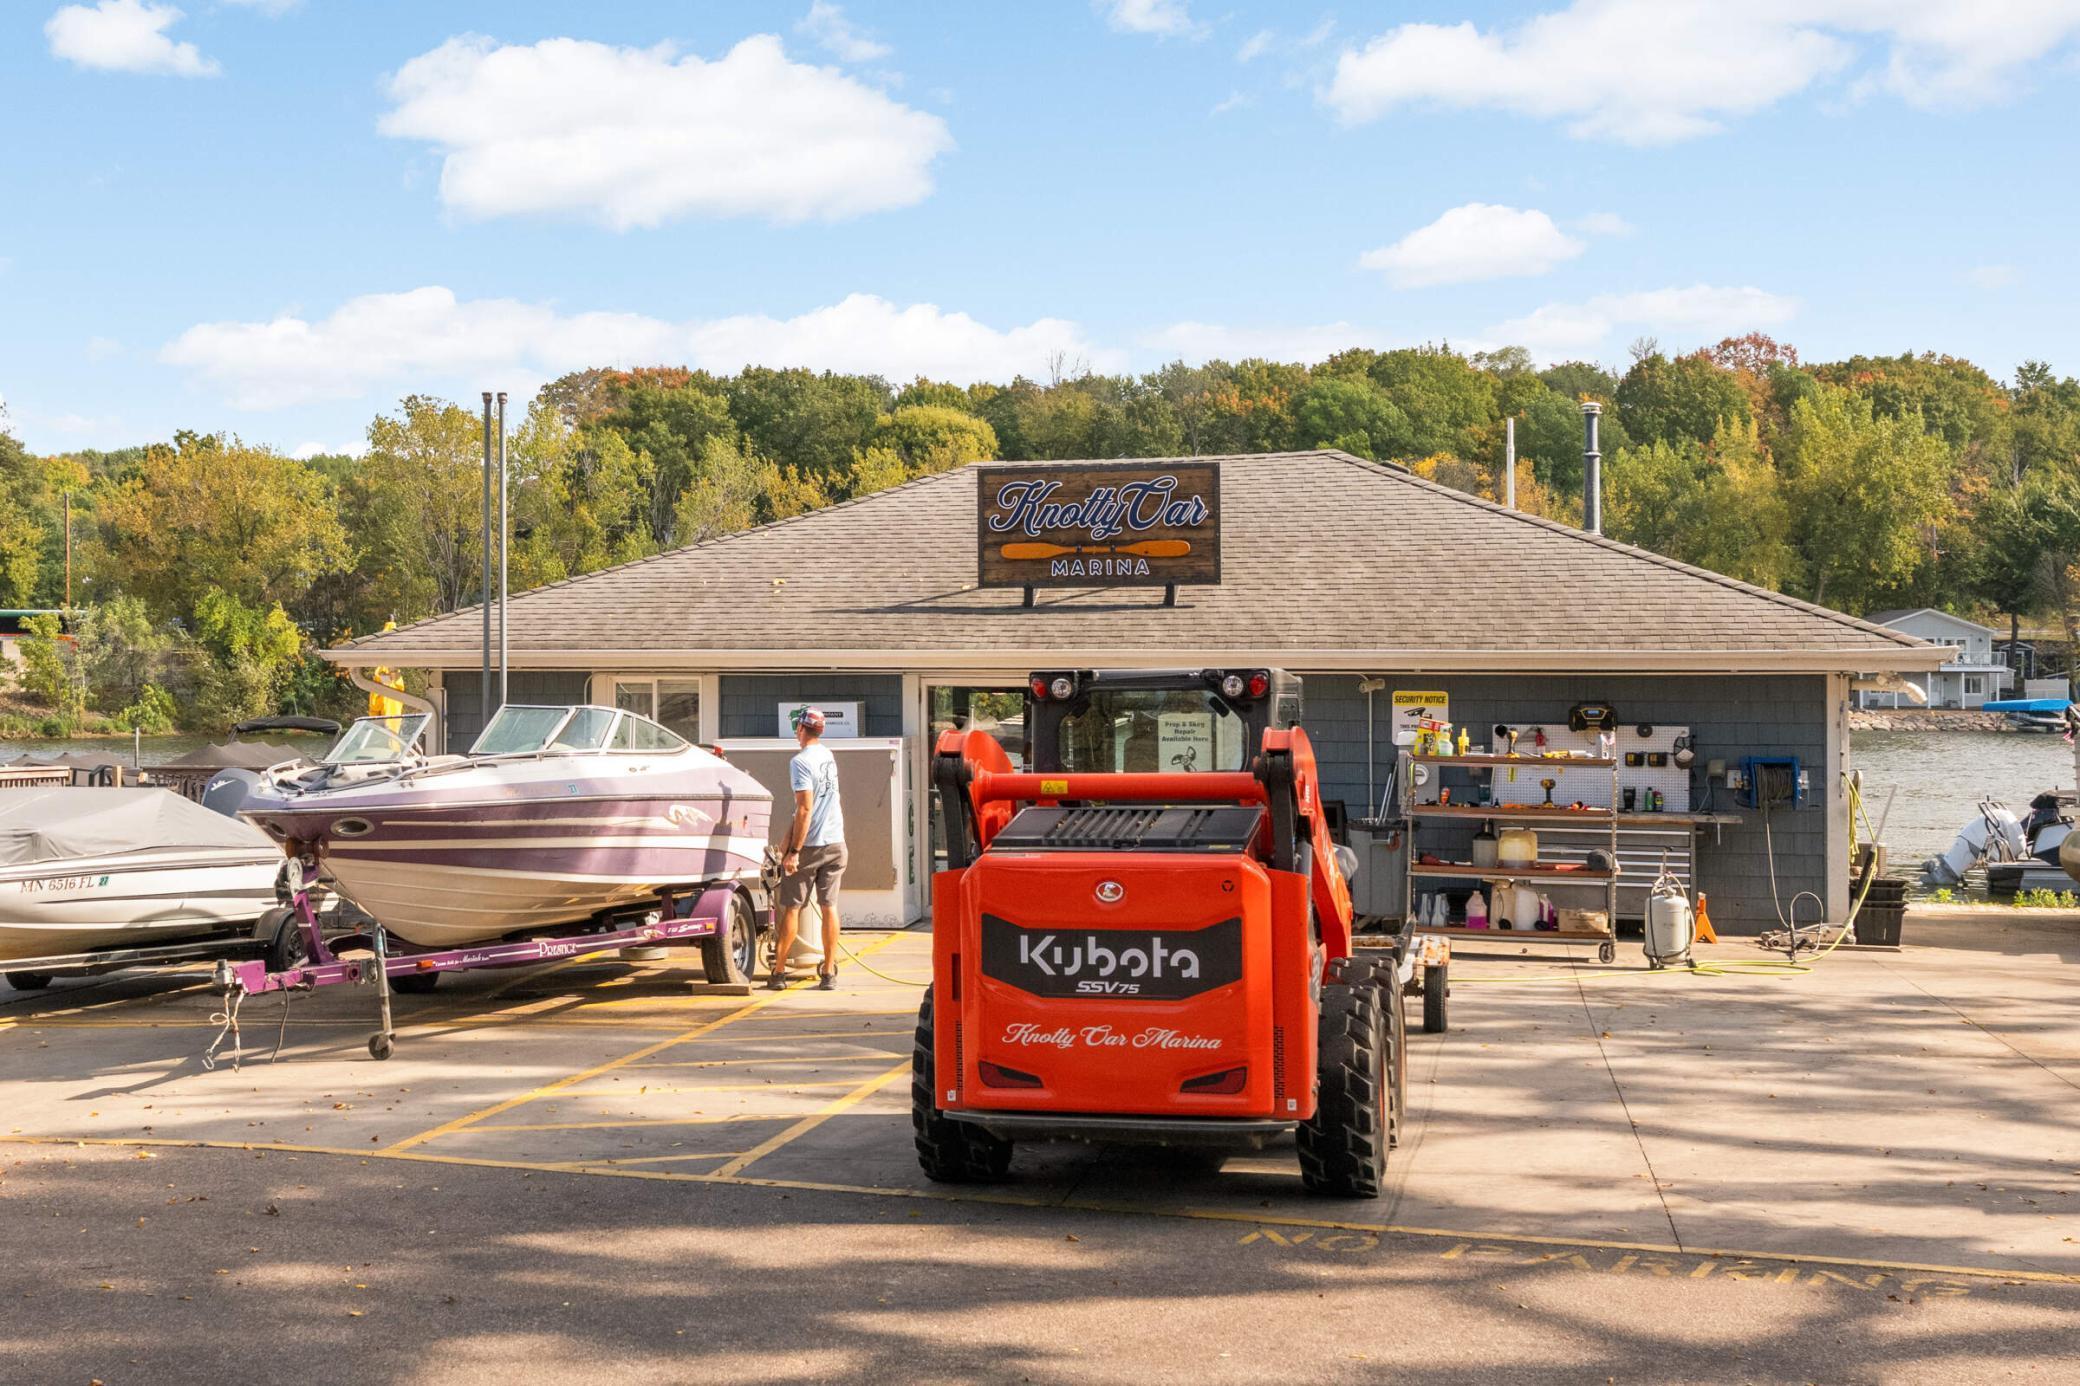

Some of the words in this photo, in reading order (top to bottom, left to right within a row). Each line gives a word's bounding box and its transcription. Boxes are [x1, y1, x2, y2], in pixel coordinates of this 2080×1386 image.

[989, 480, 1128, 541] Knotty
[1118, 475, 1209, 531] Oar
[1051, 558, 1150, 577] MARINA
[1394, 695, 1423, 703] SECURITY
[1424, 695, 1446, 703] NOTICE
[20, 879, 44, 893] MN
[48, 878, 76, 891] 6516
[79, 876, 94, 889] FL
[1020, 935, 1199, 979] Kubota
[1002, 1023, 1075, 1049] Knotty
[1080, 1024, 1128, 1048] Oar
[1132, 1027, 1222, 1051] Marina
[1239, 1228, 1379, 1252] NO
[1440, 1243, 1972, 1297] PARKING
